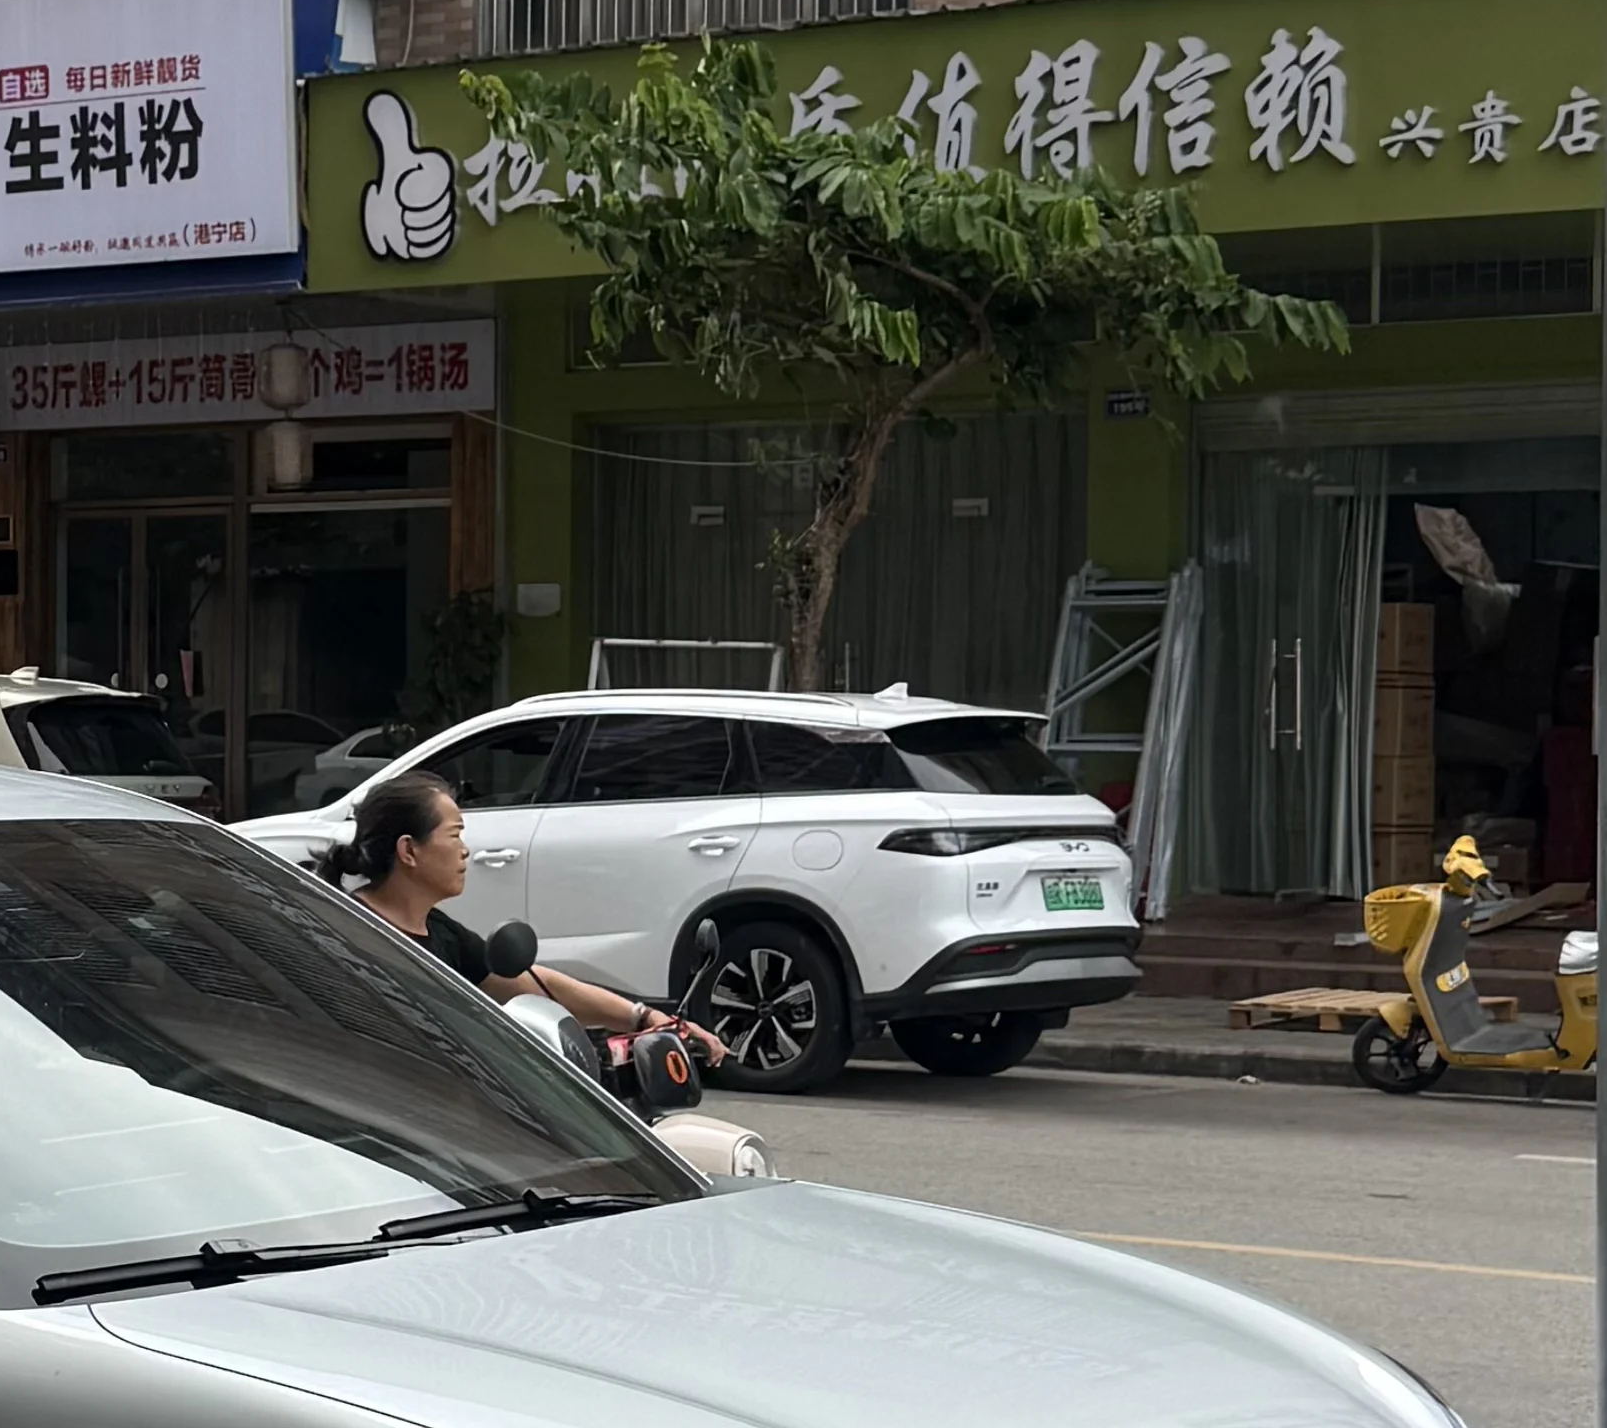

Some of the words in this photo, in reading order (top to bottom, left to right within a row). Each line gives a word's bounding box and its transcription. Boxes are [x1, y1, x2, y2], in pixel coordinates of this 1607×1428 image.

[1, 68, 49, 101] 自选
[65, 54, 202, 93] 每日新鲜靓货
[3, 97, 204, 195] 生料粉
